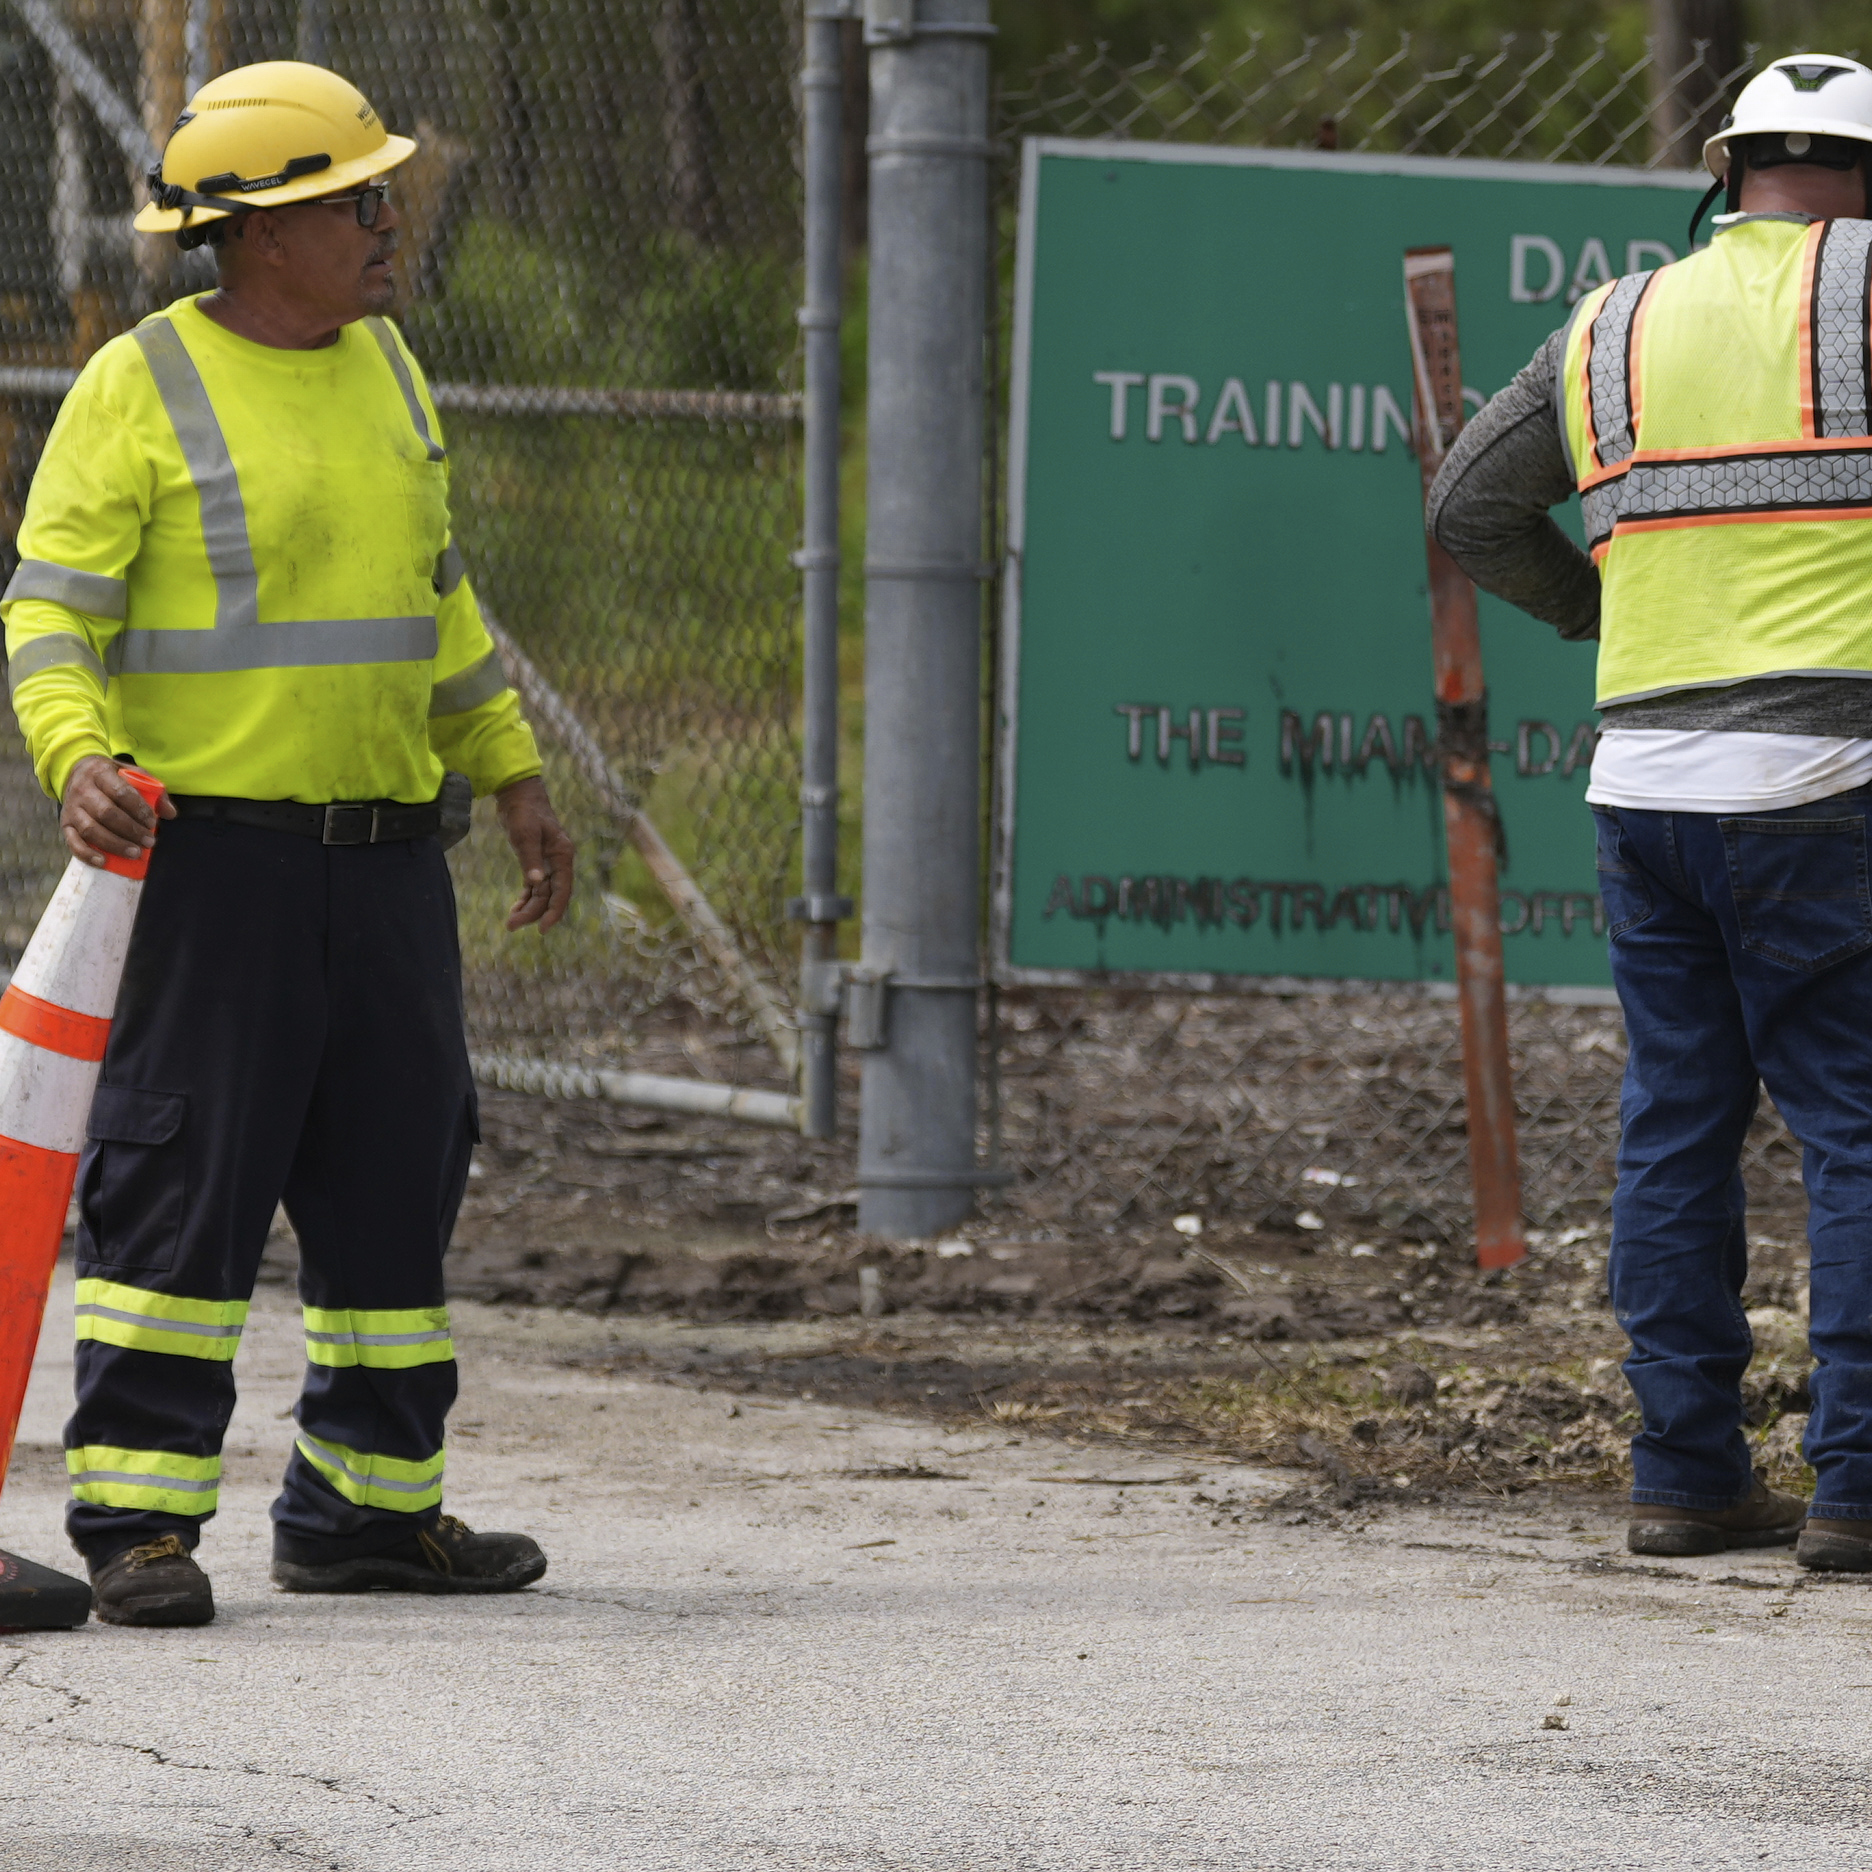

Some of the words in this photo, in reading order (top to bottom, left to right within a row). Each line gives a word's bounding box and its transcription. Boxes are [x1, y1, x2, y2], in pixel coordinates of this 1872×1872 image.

[241, 177, 282, 191] WAVECEL
[1510, 233, 1712, 306] DAD
[1116, 704, 1246, 770] THE
